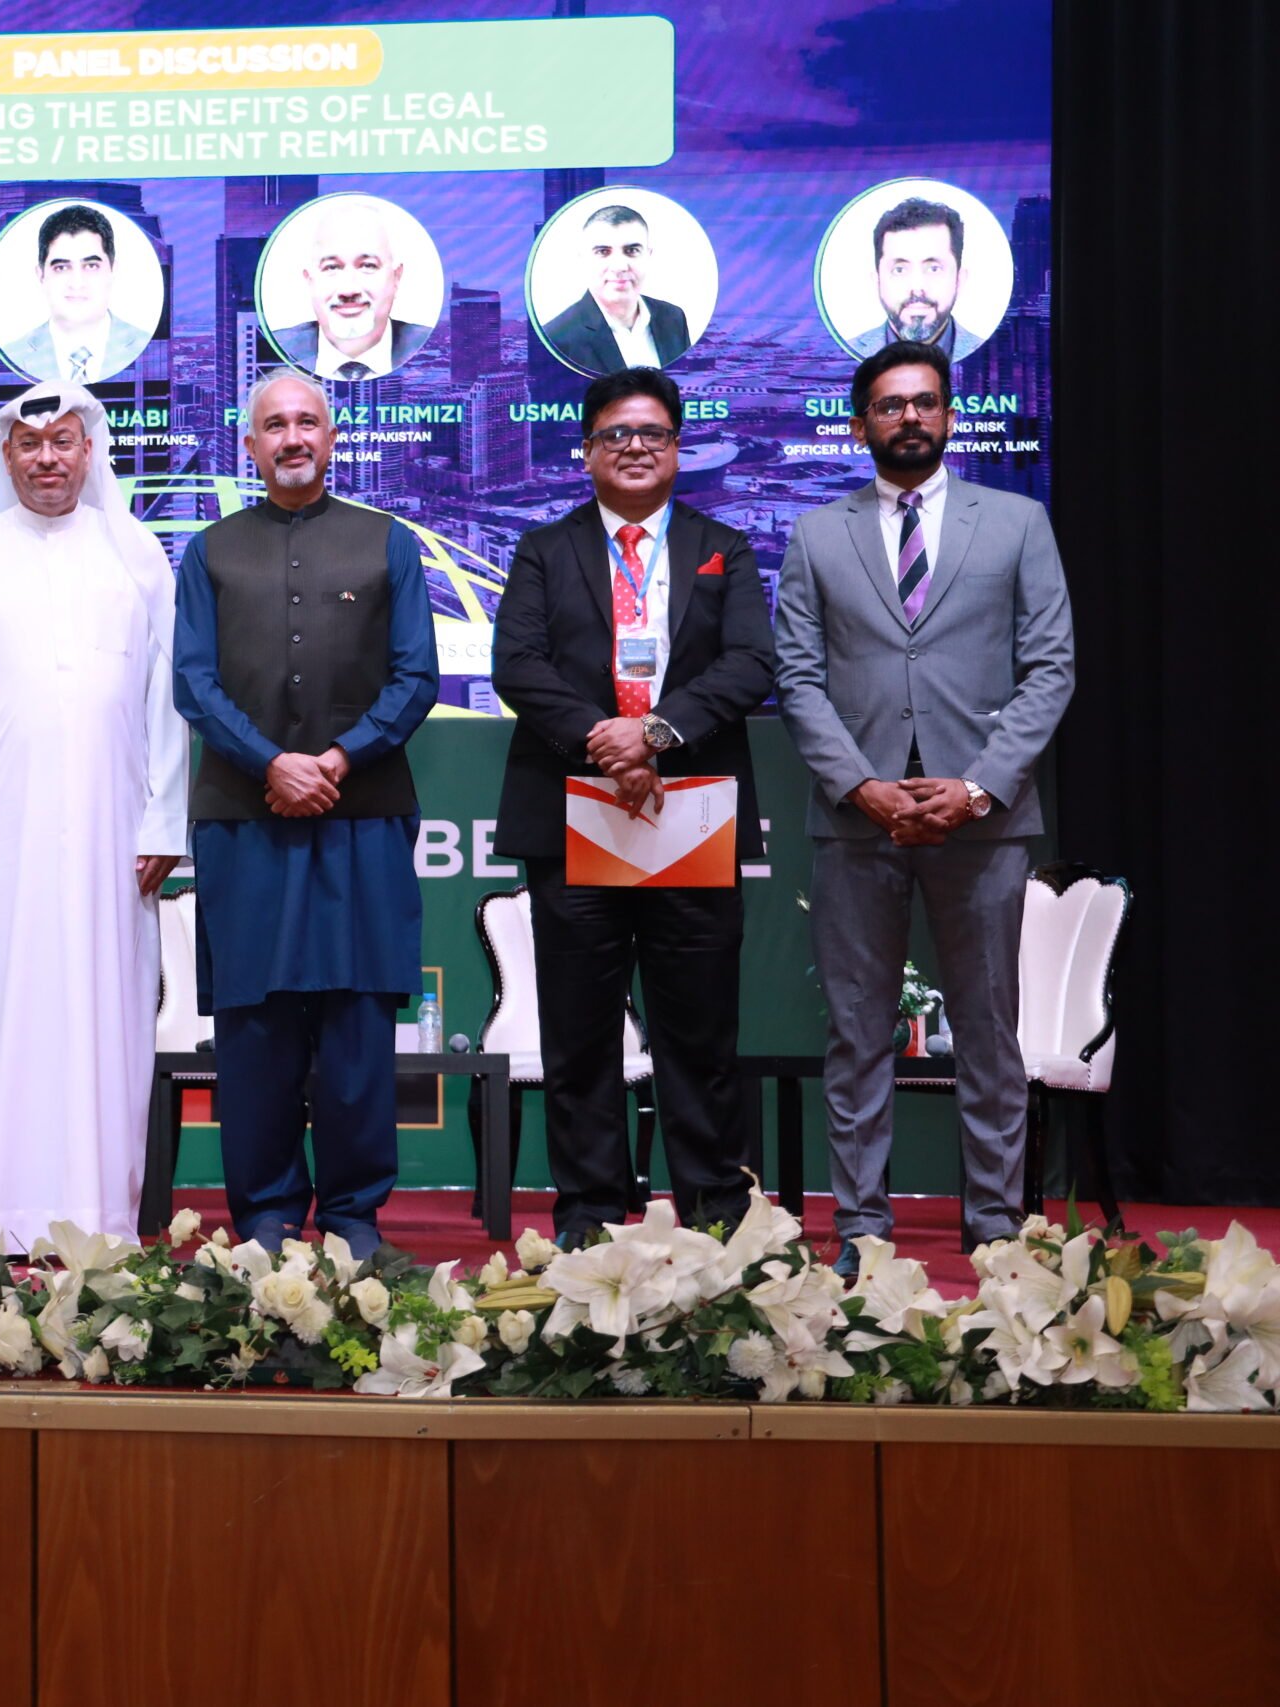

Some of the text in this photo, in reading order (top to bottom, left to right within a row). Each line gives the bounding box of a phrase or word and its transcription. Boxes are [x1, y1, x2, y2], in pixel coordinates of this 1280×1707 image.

[13, 43, 358, 78] PANEL DISCUSSION
[45, 101, 117, 129] THE
[128, 96, 309, 127] BENEFITS
[321, 94, 372, 123] OF
[382, 92, 505, 121] LEGAL
[51, 136, 65, 164] /
[76, 132, 269, 163] RESILIENT
[279, 125, 548, 160] REMITTANCES
[950, 395, 1017, 413] ASAN
[376, 405, 462, 423] TIRMIZI
[975, 421, 1007, 433] RISK
[119, 435, 199, 447] REMITTANCE,
[351, 432, 368, 442] OF
[371, 431, 432, 442] PAKISTAN
[783, 444, 839, 456] OFFICER
[841, 444, 851, 455] &
[1005, 440, 1040, 452] 1LINK
[356, 451, 382, 462] UAE
